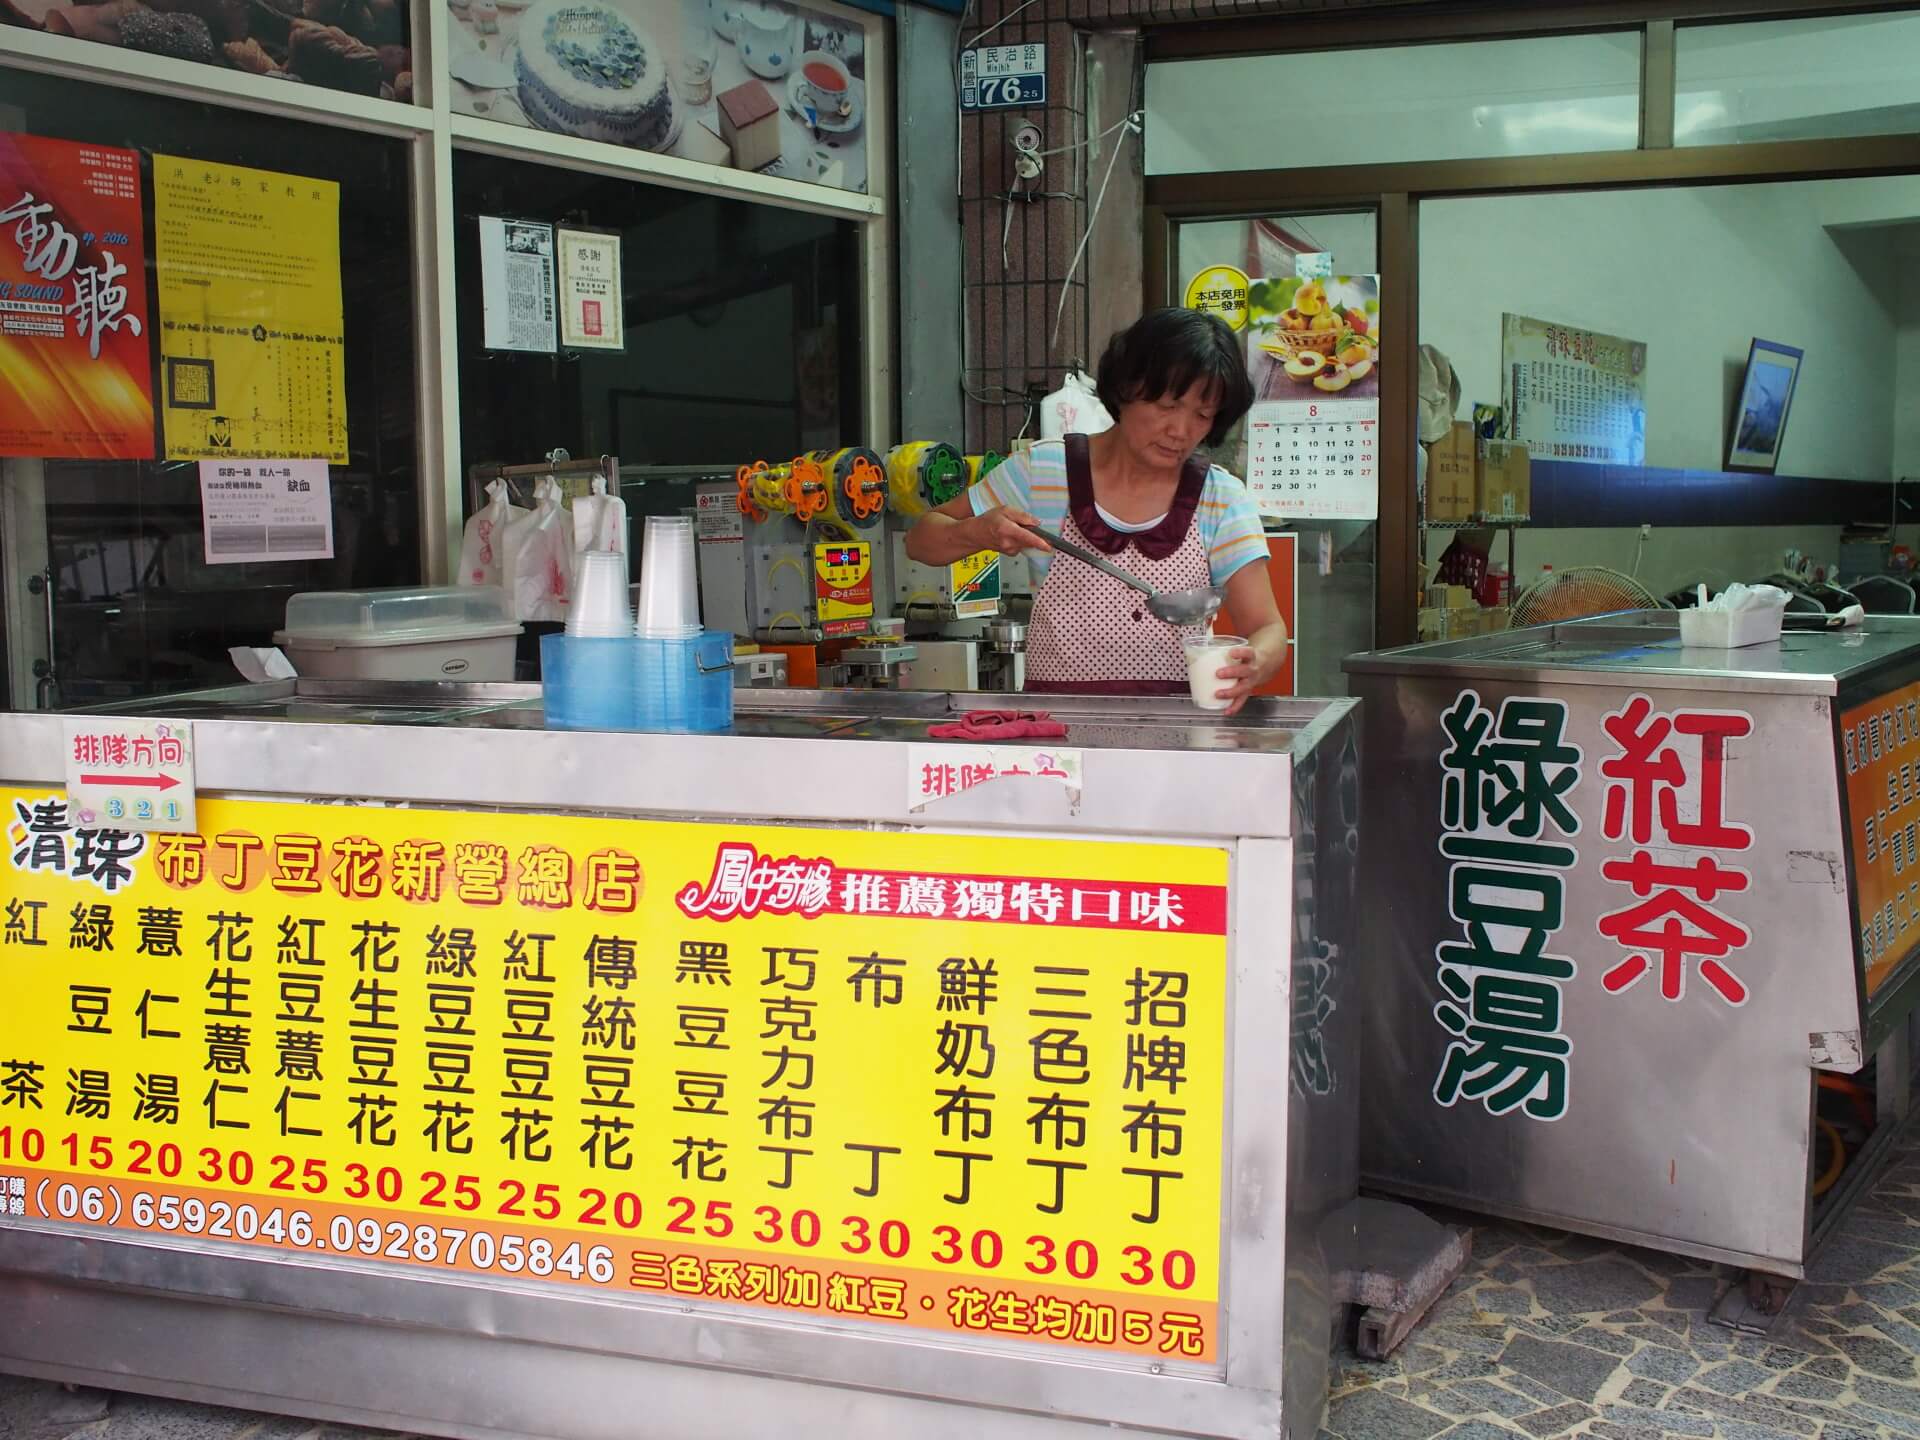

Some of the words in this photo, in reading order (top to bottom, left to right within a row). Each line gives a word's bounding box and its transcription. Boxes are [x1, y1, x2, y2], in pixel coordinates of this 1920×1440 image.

[963, 55, 977, 104] 新營區
[981, 77, 1021, 104] 76
[1023, 89, 1038, 98] 25
[987, 45, 1036, 63] 民治路
[15, 283, 64, 301] SOUND
[102, 233, 128, 245] 2016
[578, 248, 601, 261] 感謝
[287, 479, 311, 492] 缺血
[1309, 405, 1317, 417] 8
[13, 800, 145, 890] 清珠
[157, 833, 640, 912] 布丁豆花新營總店
[73, 734, 184, 766] 排隊方向
[109, 799, 122, 818] 3
[137, 800, 151, 818] 2
[167, 801, 177, 819] 1
[921, 763, 1068, 797] 排隊
[1597, 693, 1754, 1006] 紅茶
[1, 897, 48, 1110] 紅茶
[66, 901, 114, 1120] 綠豆湯
[841, 873, 1185, 929] 推薦獨特口味
[1434, 689, 1583, 1120] 綠豆湯
[133, 905, 182, 1125] 薏仁湯
[204, 910, 253, 1130] 花生薏仁
[275, 914, 325, 1138] 紅豆薏仁
[347, 919, 401, 1147] 花生豆花
[422, 925, 477, 1154] 綠豆豆花
[501, 929, 556, 1162] 紅豆豆花
[580, 934, 638, 1171] 傳統豆花
[672, 940, 732, 1182] 黑豆豆花
[757, 946, 819, 1189] 巧克力布丁
[844, 951, 907, 1197] 布丁
[933, 956, 1000, 1205] 鮮奶布丁
[1026, 966, 1093, 1214] 三色布丁
[1122, 967, 1189, 1224] 招牌布丁
[0, 1126, 45, 1162] 10
[61, 1132, 113, 1170] 15
[127, 1140, 183, 1177] 20
[198, 1147, 254, 1185] 30
[269, 1155, 328, 1193] 25
[343, 1163, 403, 1201] 30
[420, 1171, 481, 1211] 25
[497, 1180, 561, 1220] 25
[577, 1188, 642, 1229] 20
[665, 1196, 734, 1238] 25
[753, 1205, 821, 1248] 30
[840, 1215, 911, 1258] 30
[931, 1225, 1003, 1269] 30
[1024, 1235, 1099, 1279] 30
[1120, 1245, 1196, 1290] 30
